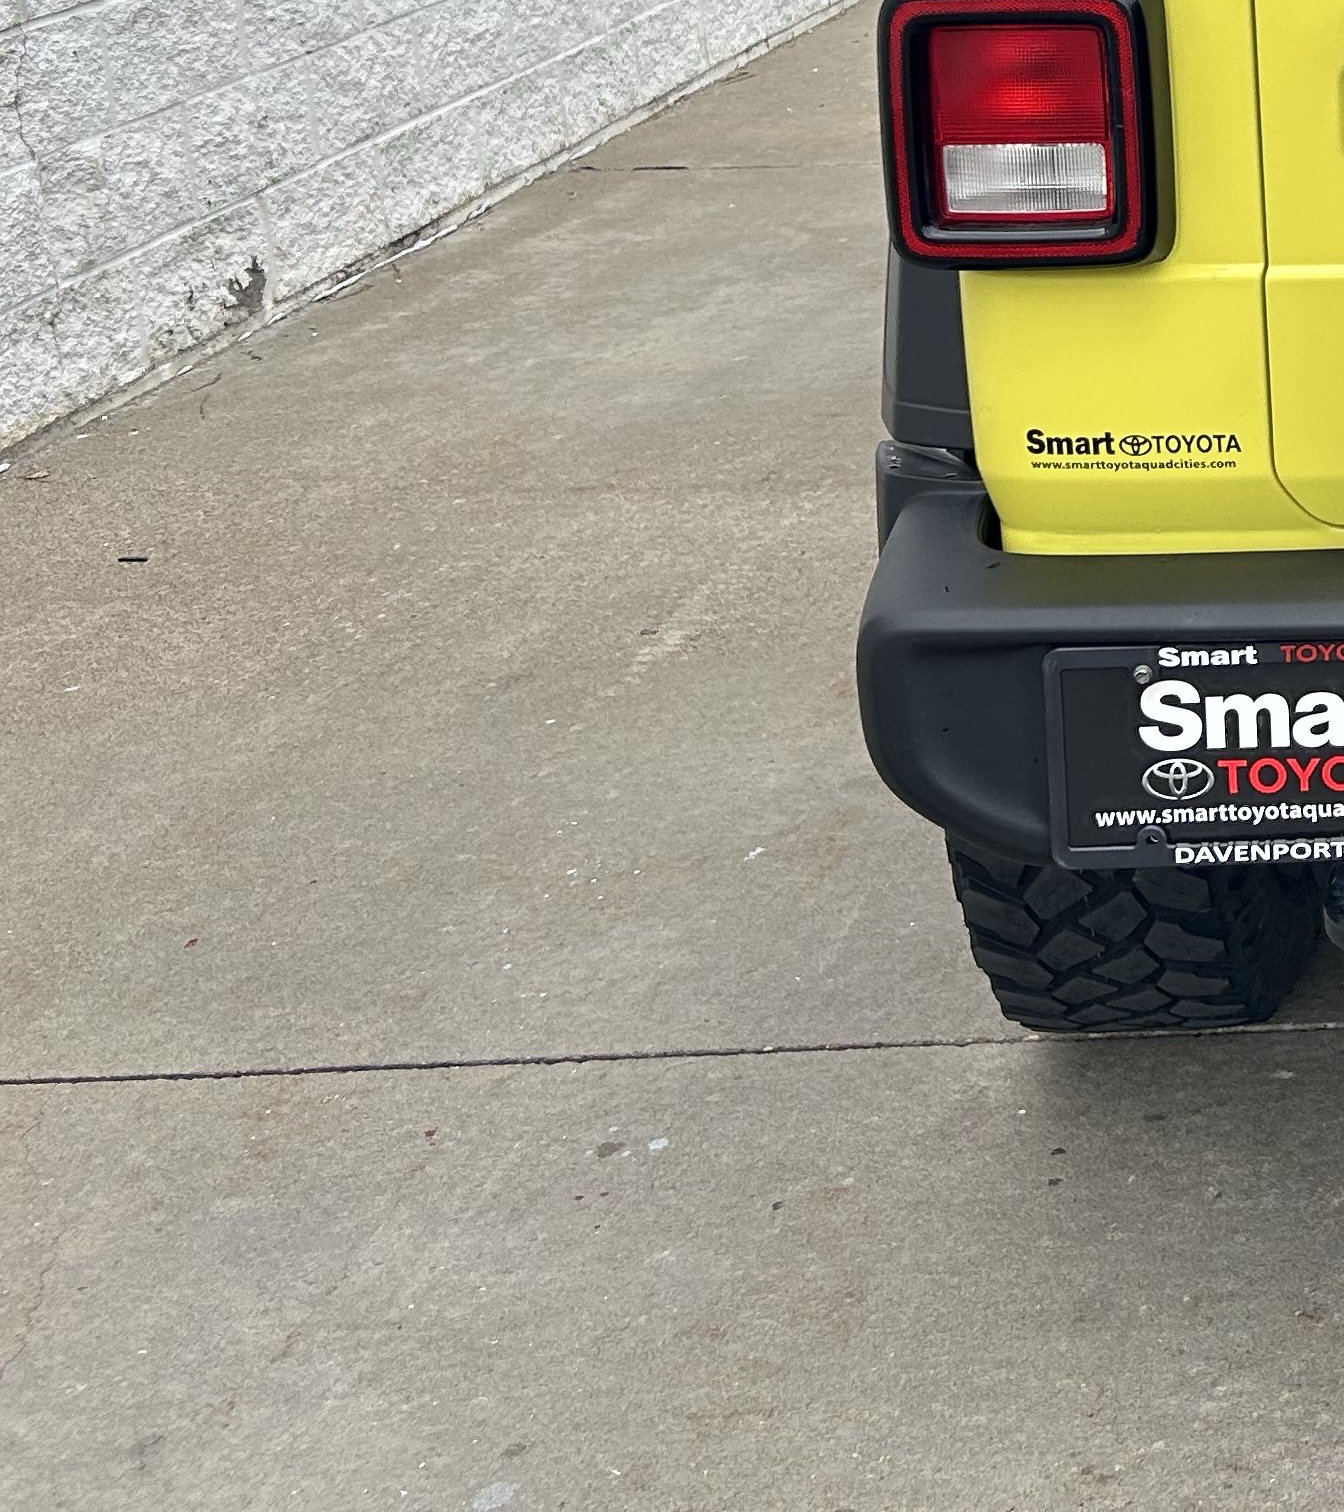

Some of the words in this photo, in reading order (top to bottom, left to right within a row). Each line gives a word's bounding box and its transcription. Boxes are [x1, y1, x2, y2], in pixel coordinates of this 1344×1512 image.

[1026, 428, 1116, 455] Smart
[1151, 434, 1243, 454] TOYOTA
[1031, 458, 1238, 472] www.smarttoyotaquadcities.com
[1158, 645, 1259, 668] Smart
